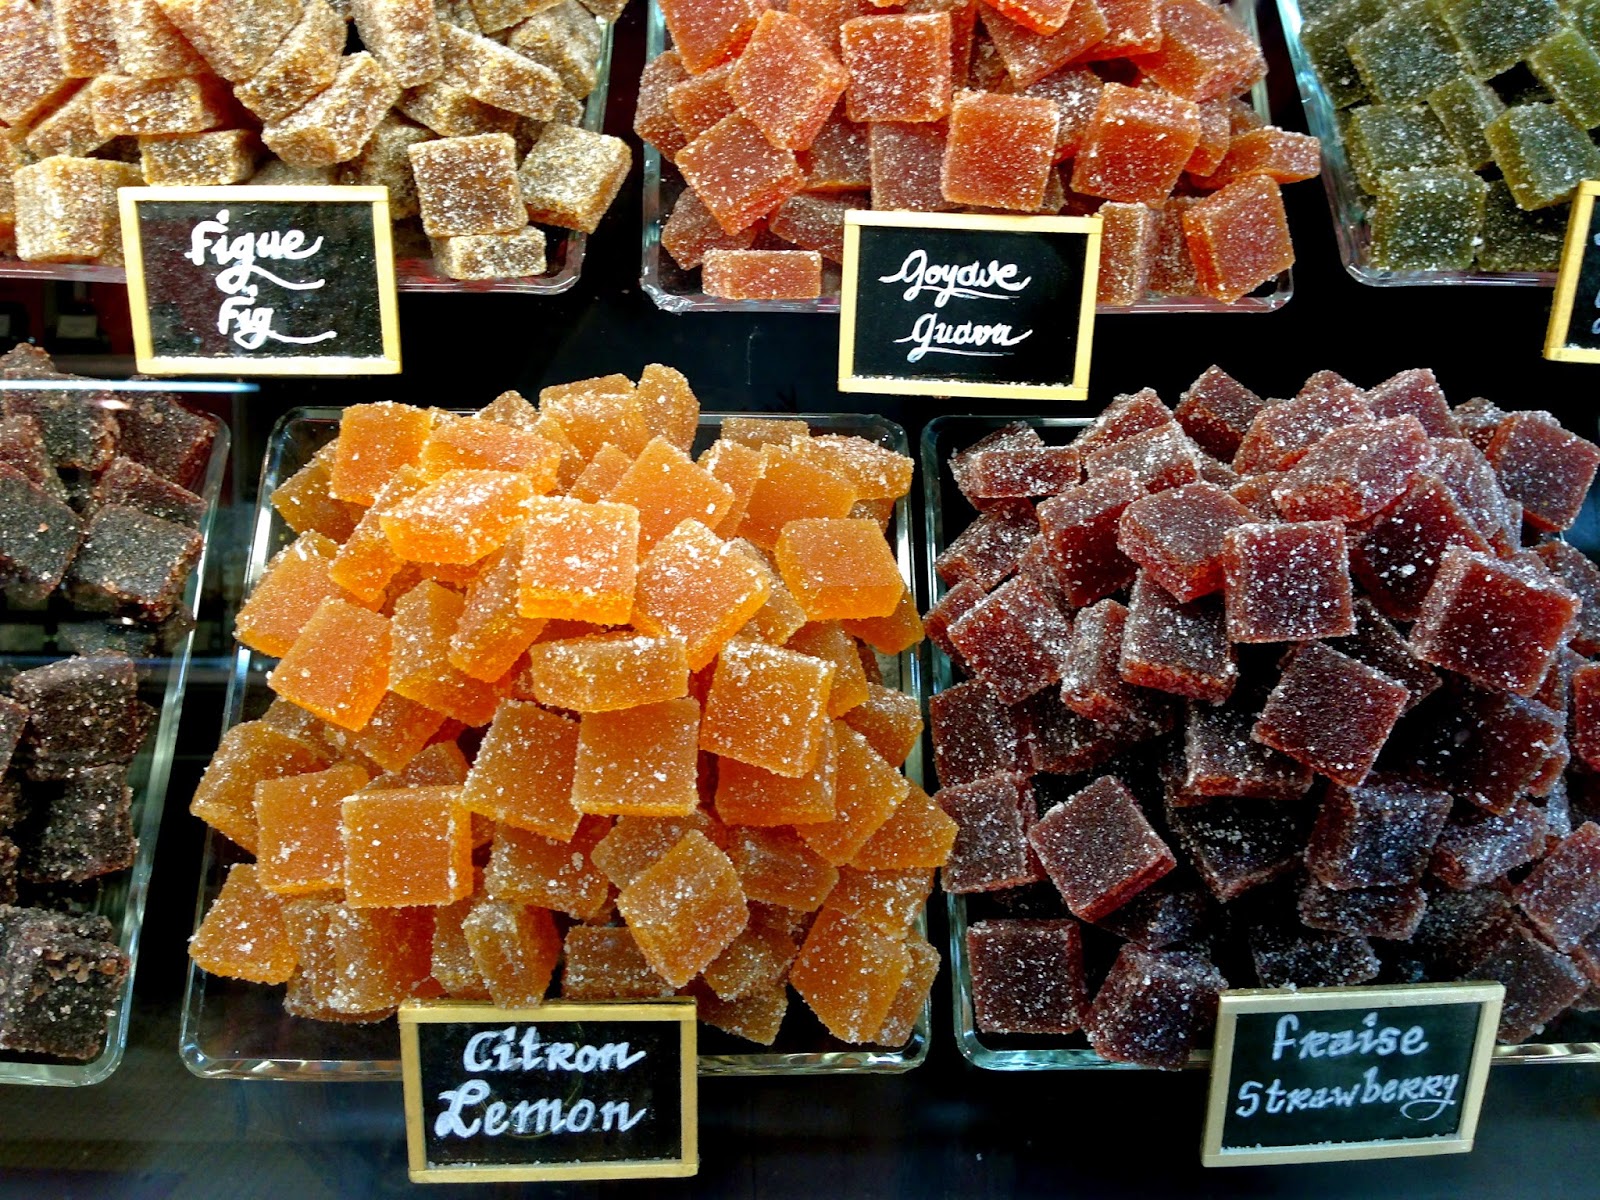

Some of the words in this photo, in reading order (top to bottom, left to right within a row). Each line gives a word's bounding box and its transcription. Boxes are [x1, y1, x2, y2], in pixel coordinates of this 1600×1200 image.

[463, 1026, 647, 1073] Citron
[434, 1079, 647, 1139] Lemon
[1235, 1066, 1460, 1121] Strawberry
